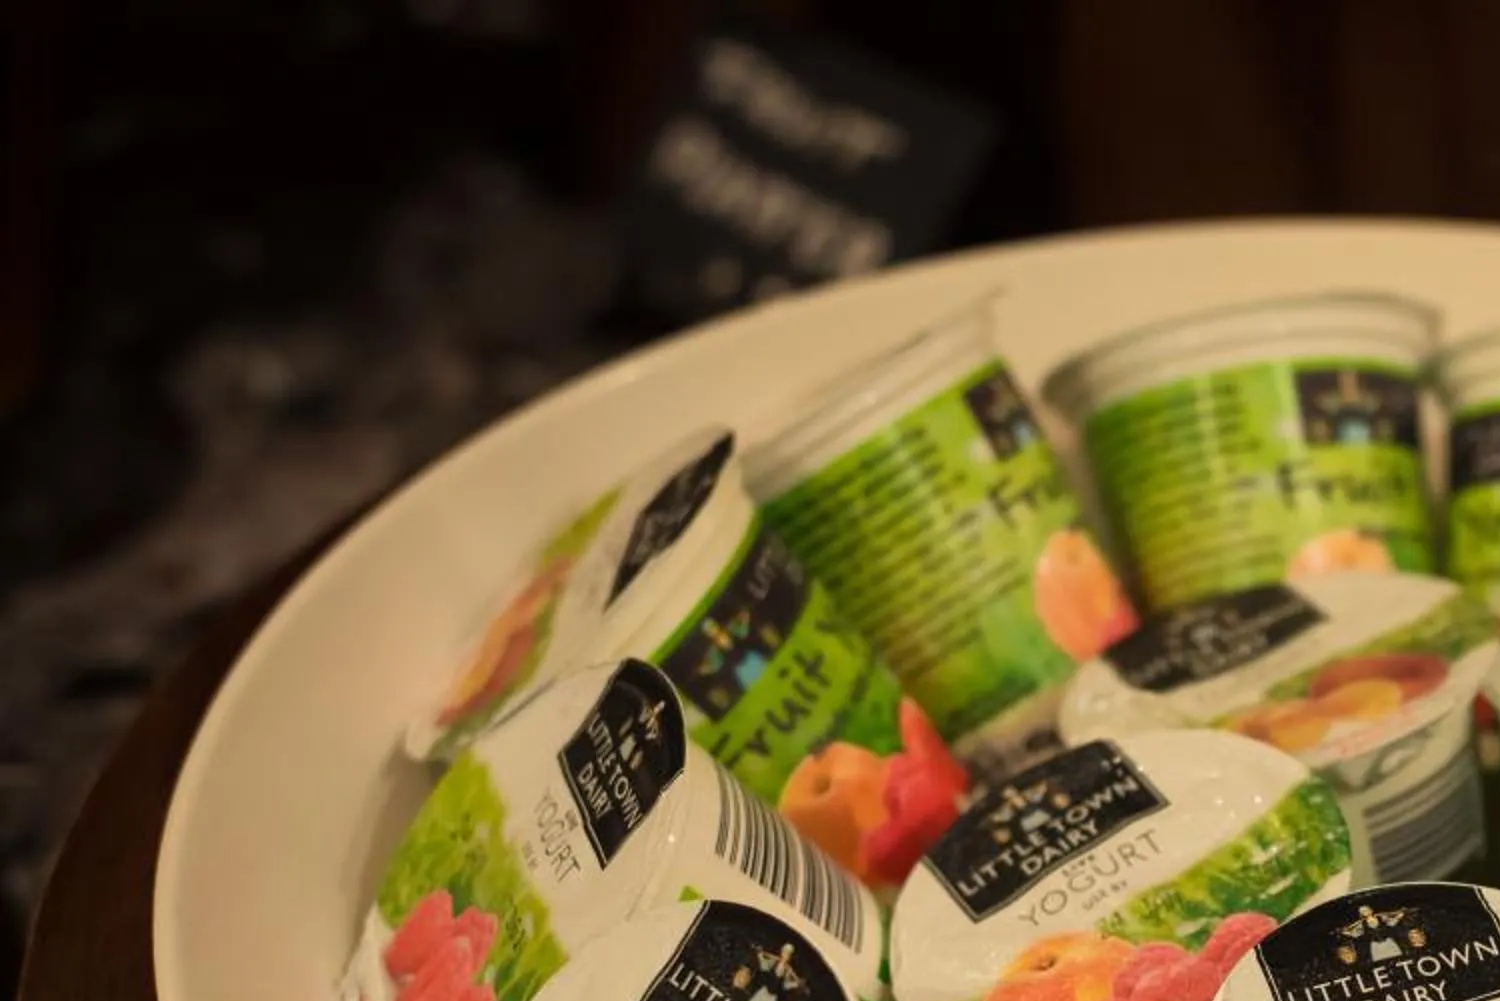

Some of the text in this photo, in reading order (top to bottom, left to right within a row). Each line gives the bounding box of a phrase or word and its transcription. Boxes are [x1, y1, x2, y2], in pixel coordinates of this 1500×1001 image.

[577, 762, 617, 819] DAIRY
[606, 766, 642, 829] TOWN
[957, 775, 1141, 898] LITTLE TOWN
[1019, 823, 1103, 878] DAIRY
[1018, 827, 1164, 929] YOGURT
[1400, 934, 1500, 981] TOWN
